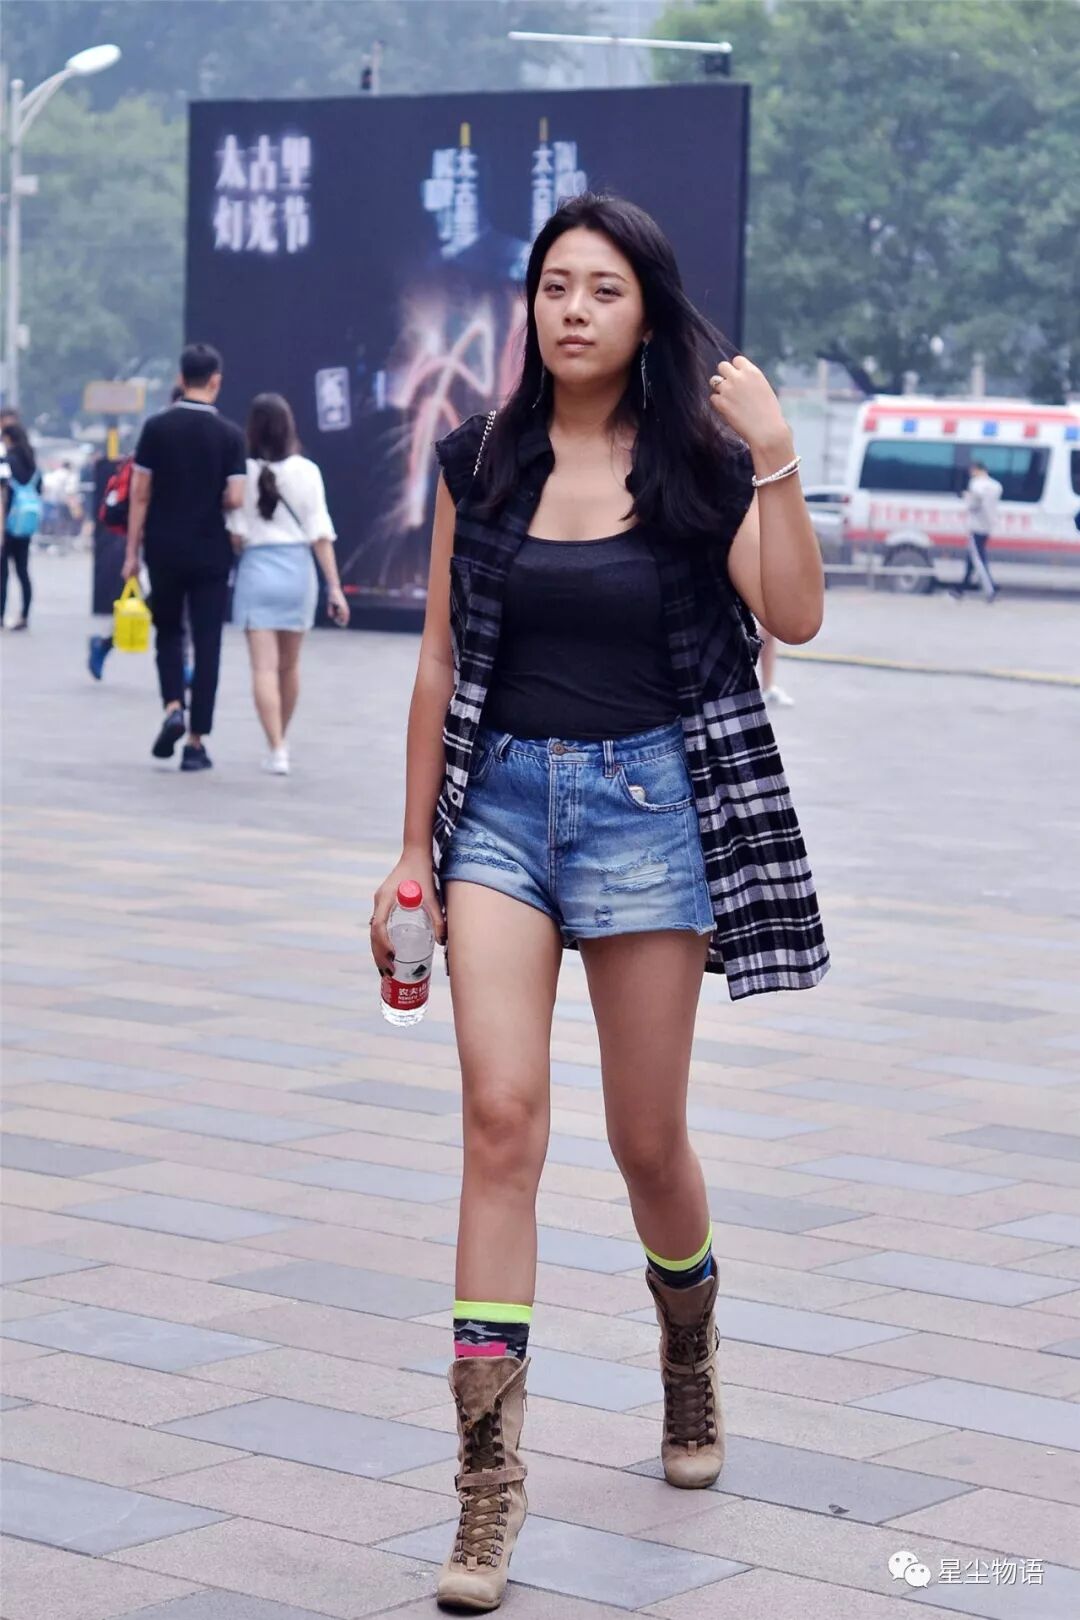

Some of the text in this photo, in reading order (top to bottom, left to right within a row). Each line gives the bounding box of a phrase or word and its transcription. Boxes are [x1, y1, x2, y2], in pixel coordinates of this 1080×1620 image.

[214, 134, 311, 191] 太古里
[213, 194, 310, 254] 灯光节
